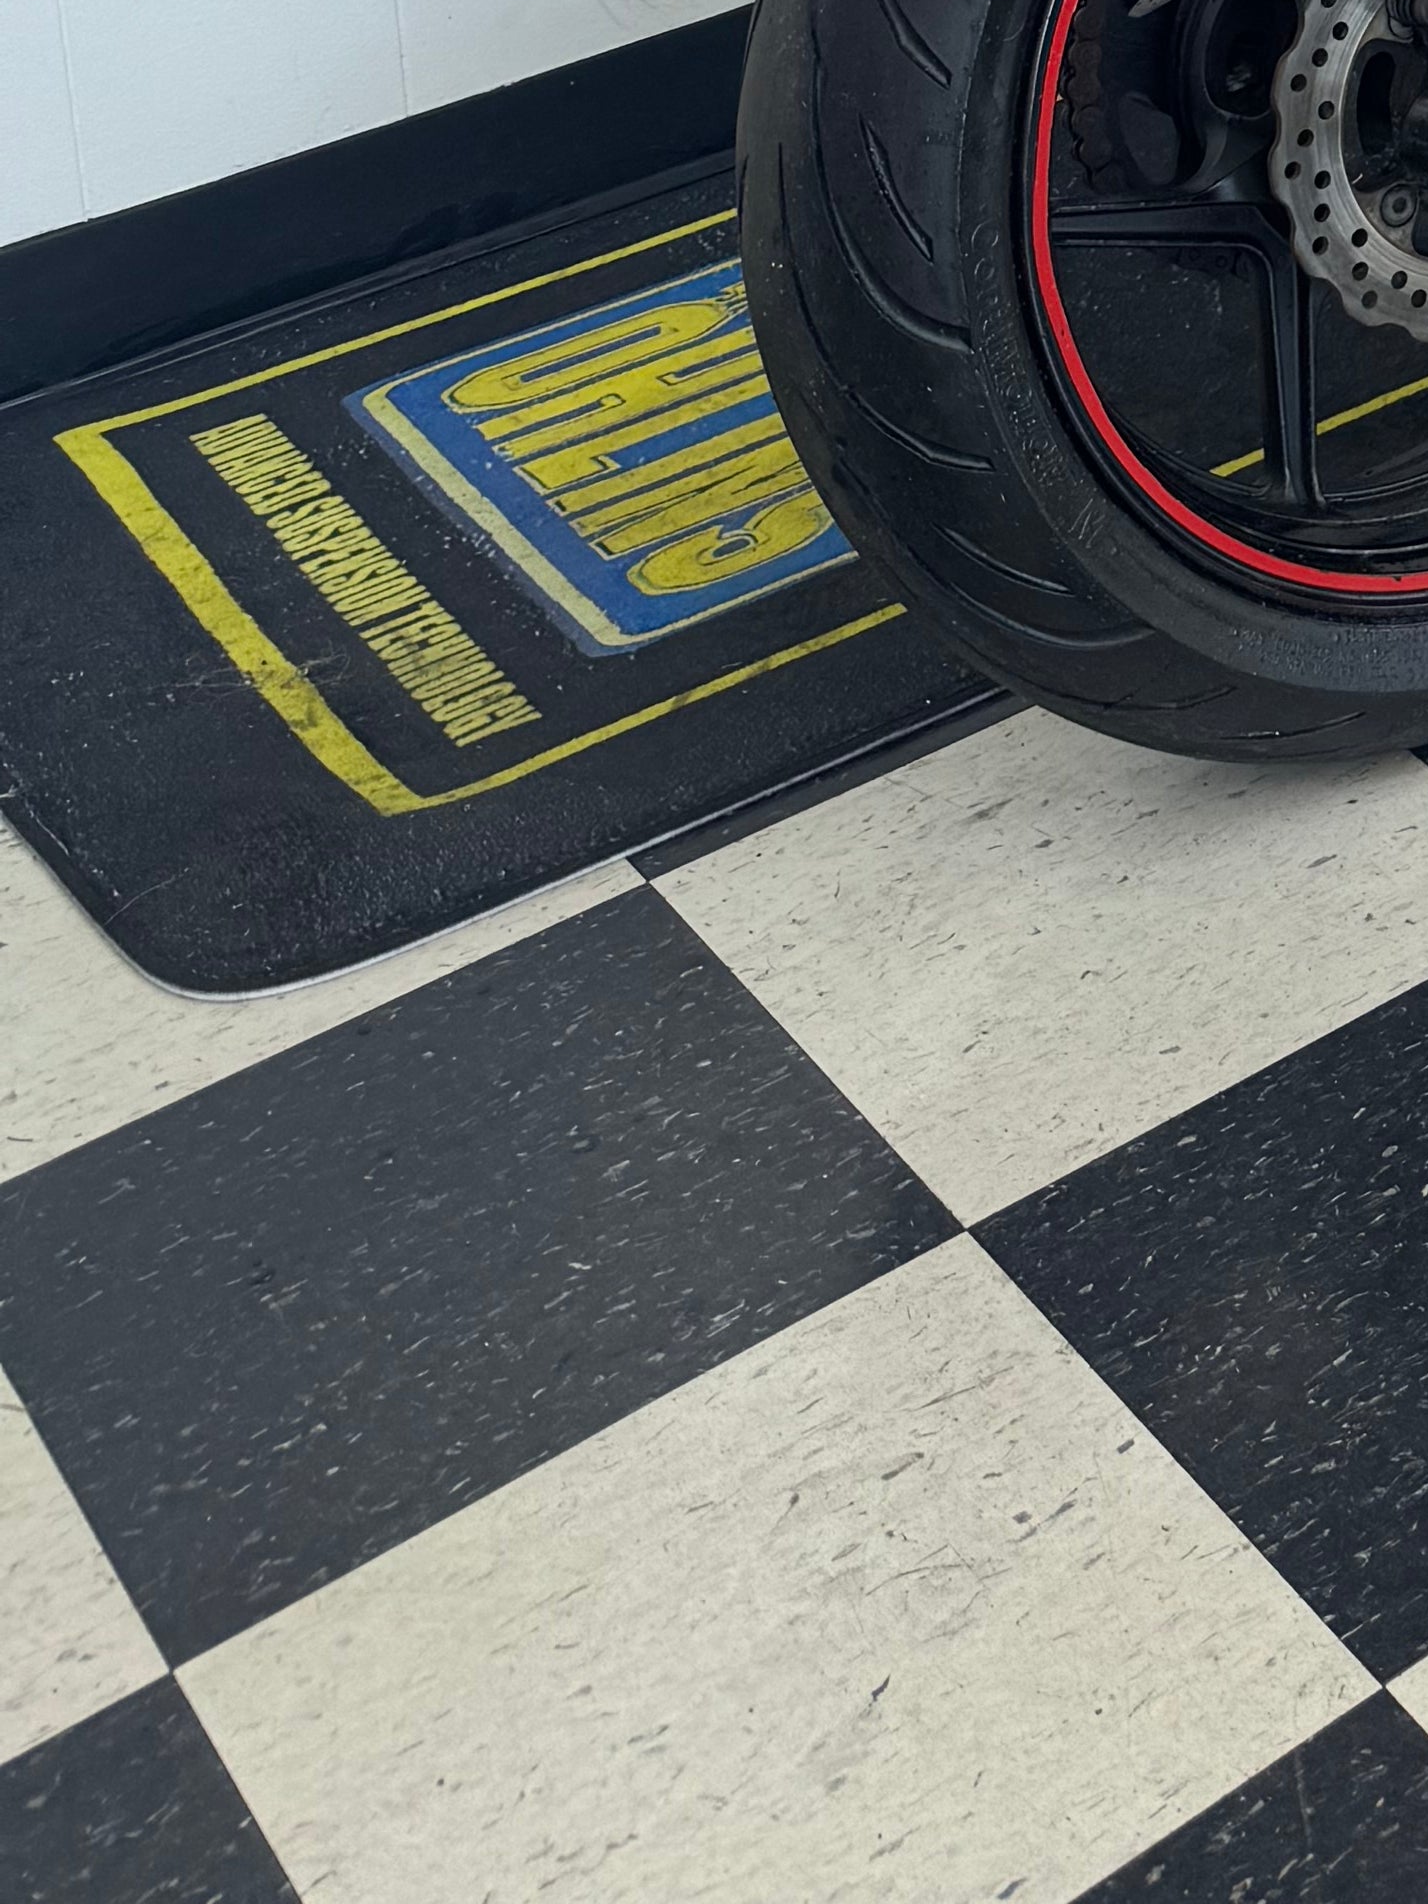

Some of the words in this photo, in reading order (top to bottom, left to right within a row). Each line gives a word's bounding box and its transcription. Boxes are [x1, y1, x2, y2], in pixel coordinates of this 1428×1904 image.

[188, 412, 332, 517] ADVANCED
[265, 494, 432, 627] SUSPENSION
[358, 600, 543, 748] TECHNOLOGY
